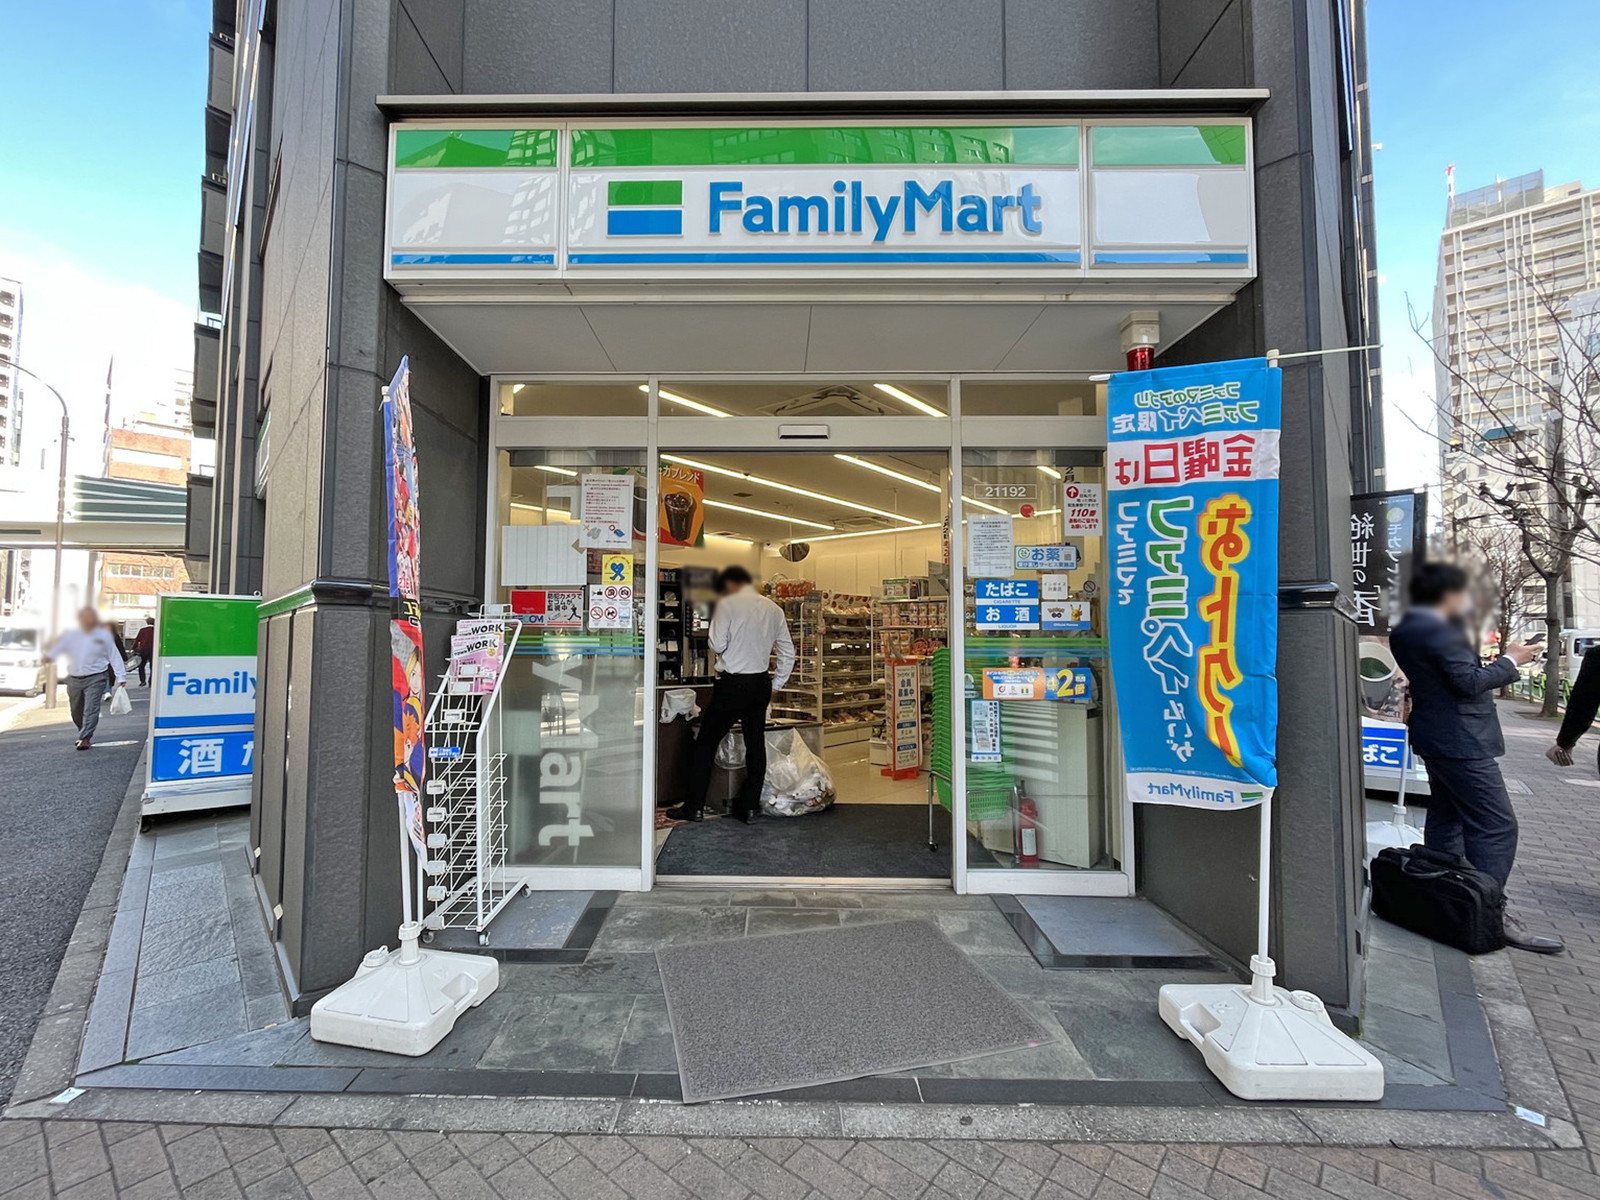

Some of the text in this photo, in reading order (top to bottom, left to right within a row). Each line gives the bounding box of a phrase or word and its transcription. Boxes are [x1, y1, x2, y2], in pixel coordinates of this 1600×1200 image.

[709, 179, 1042, 245] FamilyMart
[985, 486, 1026, 497] 21192
[1031, 547, 1060, 561] お薬
[985, 582, 1029, 597] たばこ
[471, 623, 503, 635] WORK
[466, 639, 498, 652] WORK
